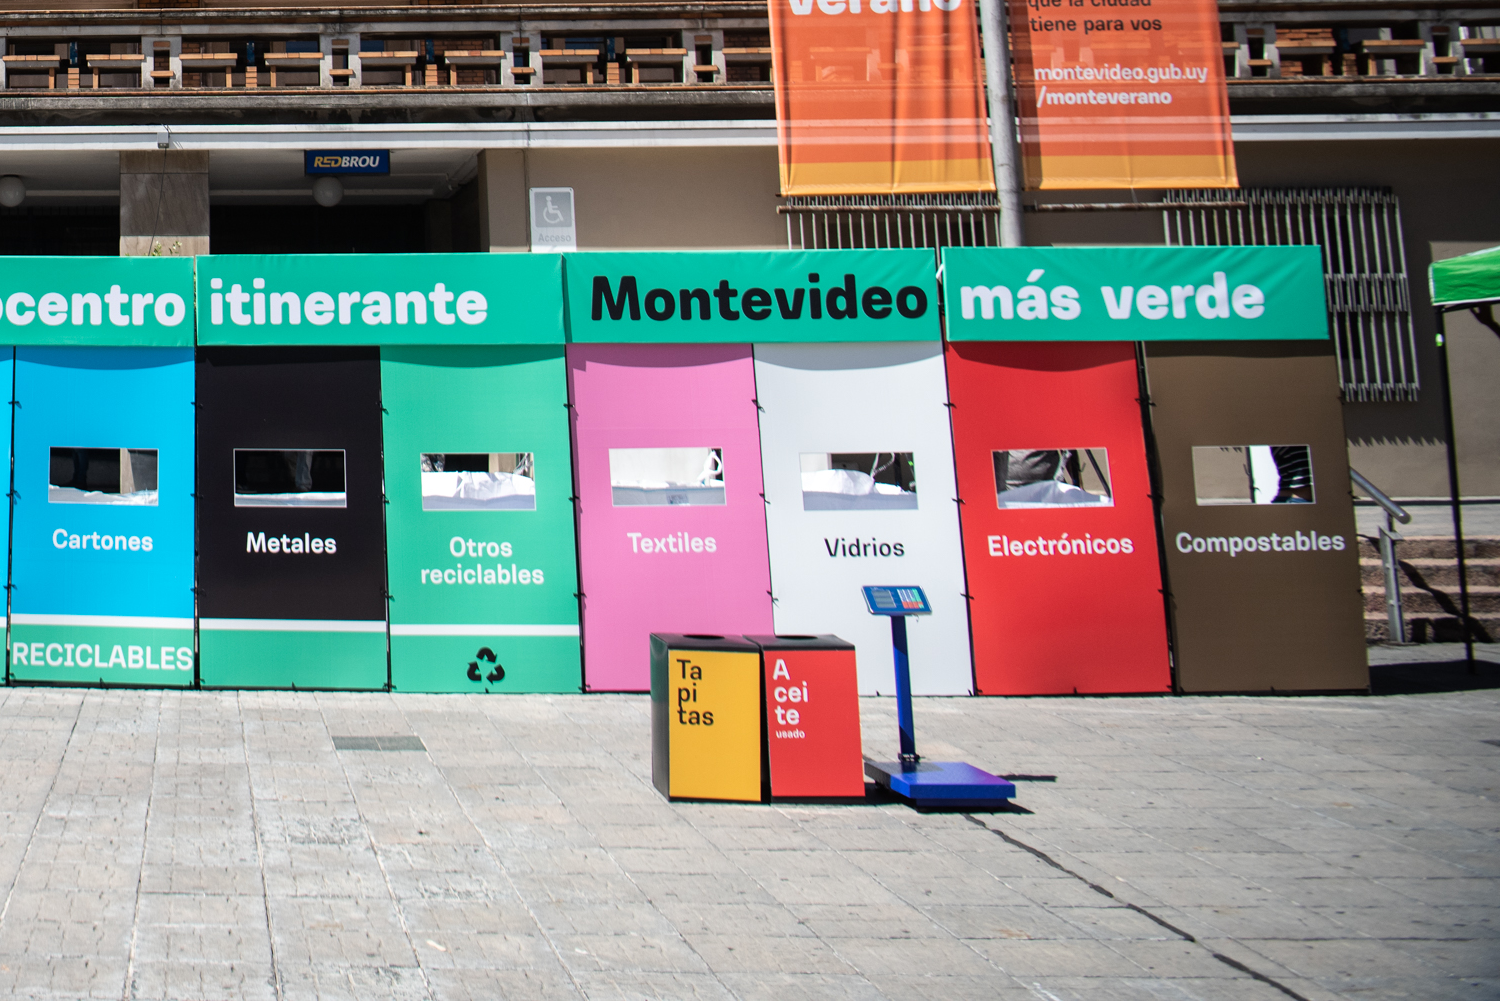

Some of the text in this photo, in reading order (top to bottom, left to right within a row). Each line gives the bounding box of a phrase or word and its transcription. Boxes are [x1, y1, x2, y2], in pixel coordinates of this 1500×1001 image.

[1029, 15, 1162, 35] tiene para vos
[1034, 63, 1208, 84] montevideo.gub.uy
[1036, 87, 1173, 108] /monteverano
[313, 155, 380, 169] REDBROU
[537, 233, 572, 243] Acceso
[210, 277, 489, 327] itinerante
[591, 272, 928, 322] Montevideo
[960, 268, 1083, 321] más
[1100, 271, 1266, 321] verde
[52, 528, 154, 553] Cartones
[245, 531, 338, 555] Metales
[449, 535, 513, 558] Otros
[626, 531, 718, 554] Textiles
[824, 536, 906, 559] Vidrios
[986, 531, 1135, 557] Electrónicos
[1175, 531, 1346, 558] Compostables
[420, 562, 545, 586] reciclables
[11, 640, 194, 671] RECICLABLES
[676, 658, 703, 681] Ta
[772, 658, 791, 681] A
[677, 683, 698, 706] pi
[774, 681, 809, 704] cei
[677, 705, 715, 726] tas
[775, 706, 801, 726] te
[775, 727, 806, 740] usado
